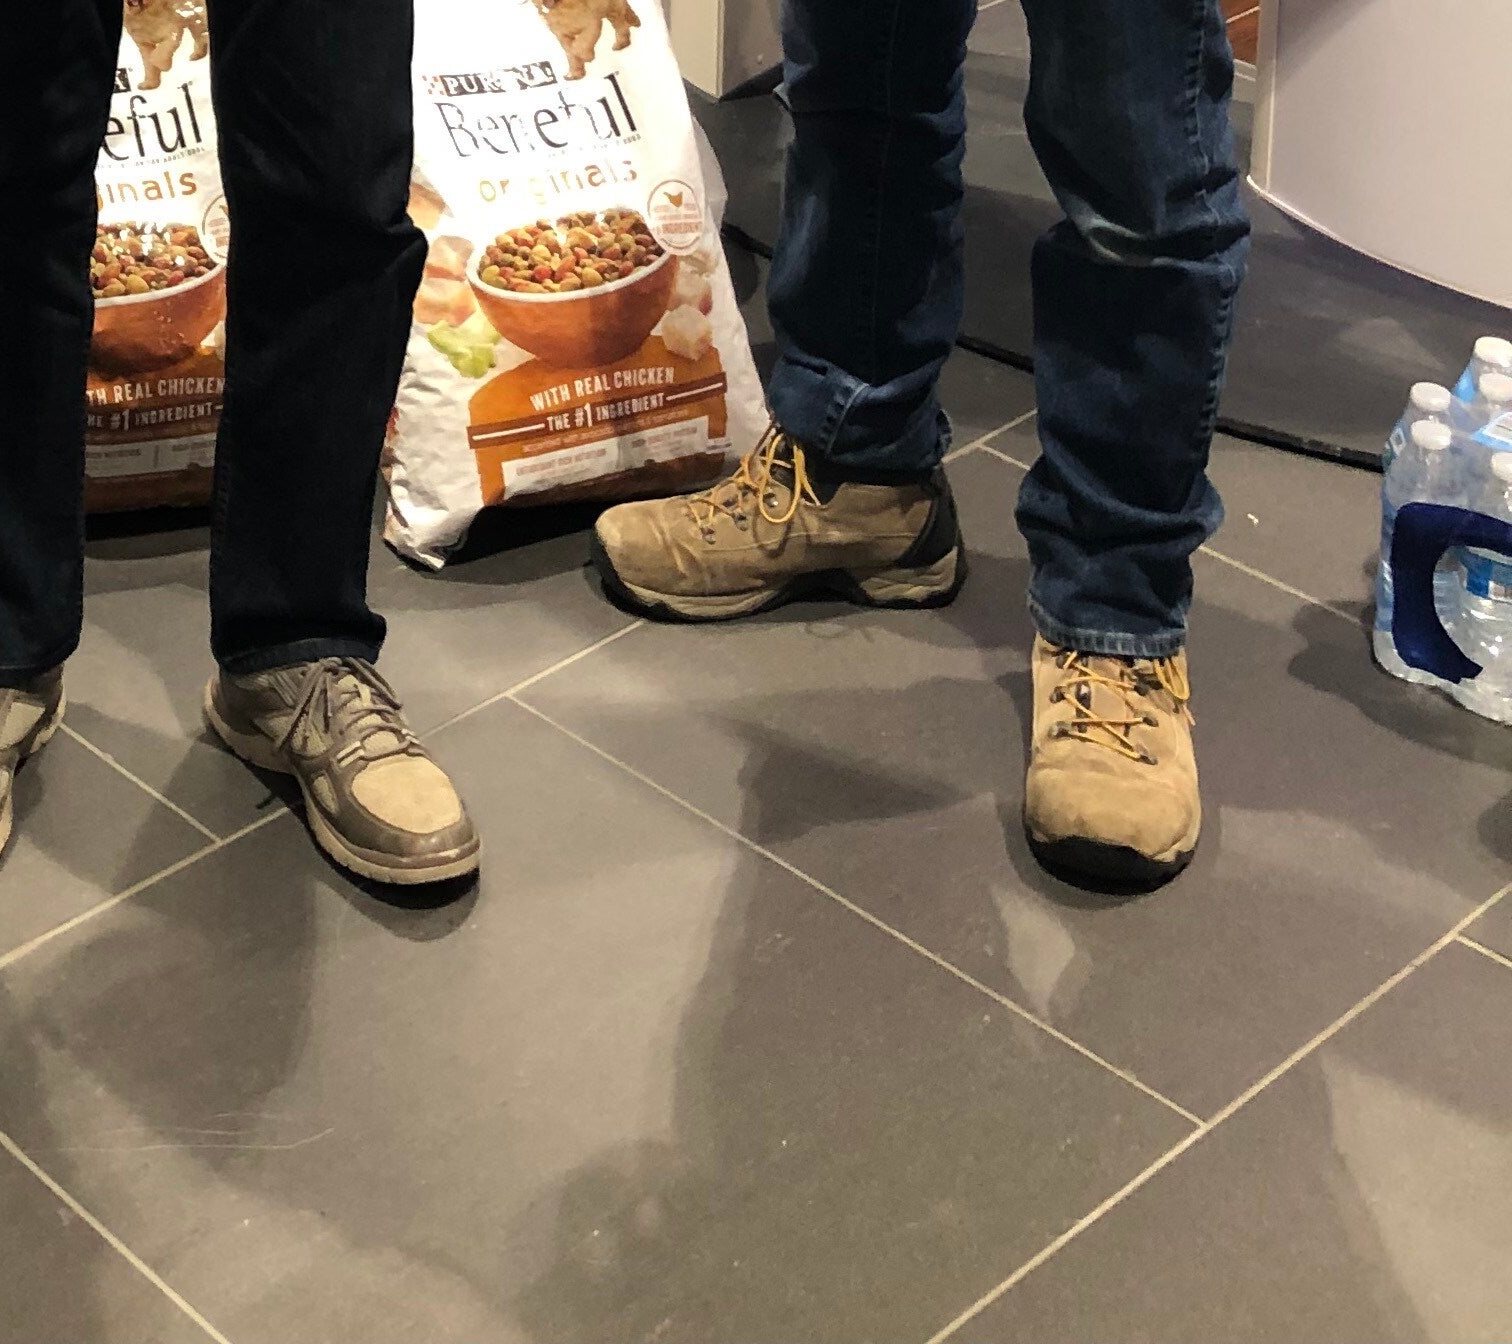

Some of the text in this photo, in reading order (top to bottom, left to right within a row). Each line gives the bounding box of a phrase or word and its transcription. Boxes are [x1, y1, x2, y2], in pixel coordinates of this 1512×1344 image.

[104, 83, 202, 161] eful
[86, 377, 225, 406] TH REAL CHICKEN
[530, 366, 675, 412] WITH REAL CHICKEN
[87, 402, 213, 431] HE #1 INGREDIENT
[547, 415, 570, 432] THE
[574, 403, 593, 429] #1
[596, 393, 665, 421] INGREDIENT
